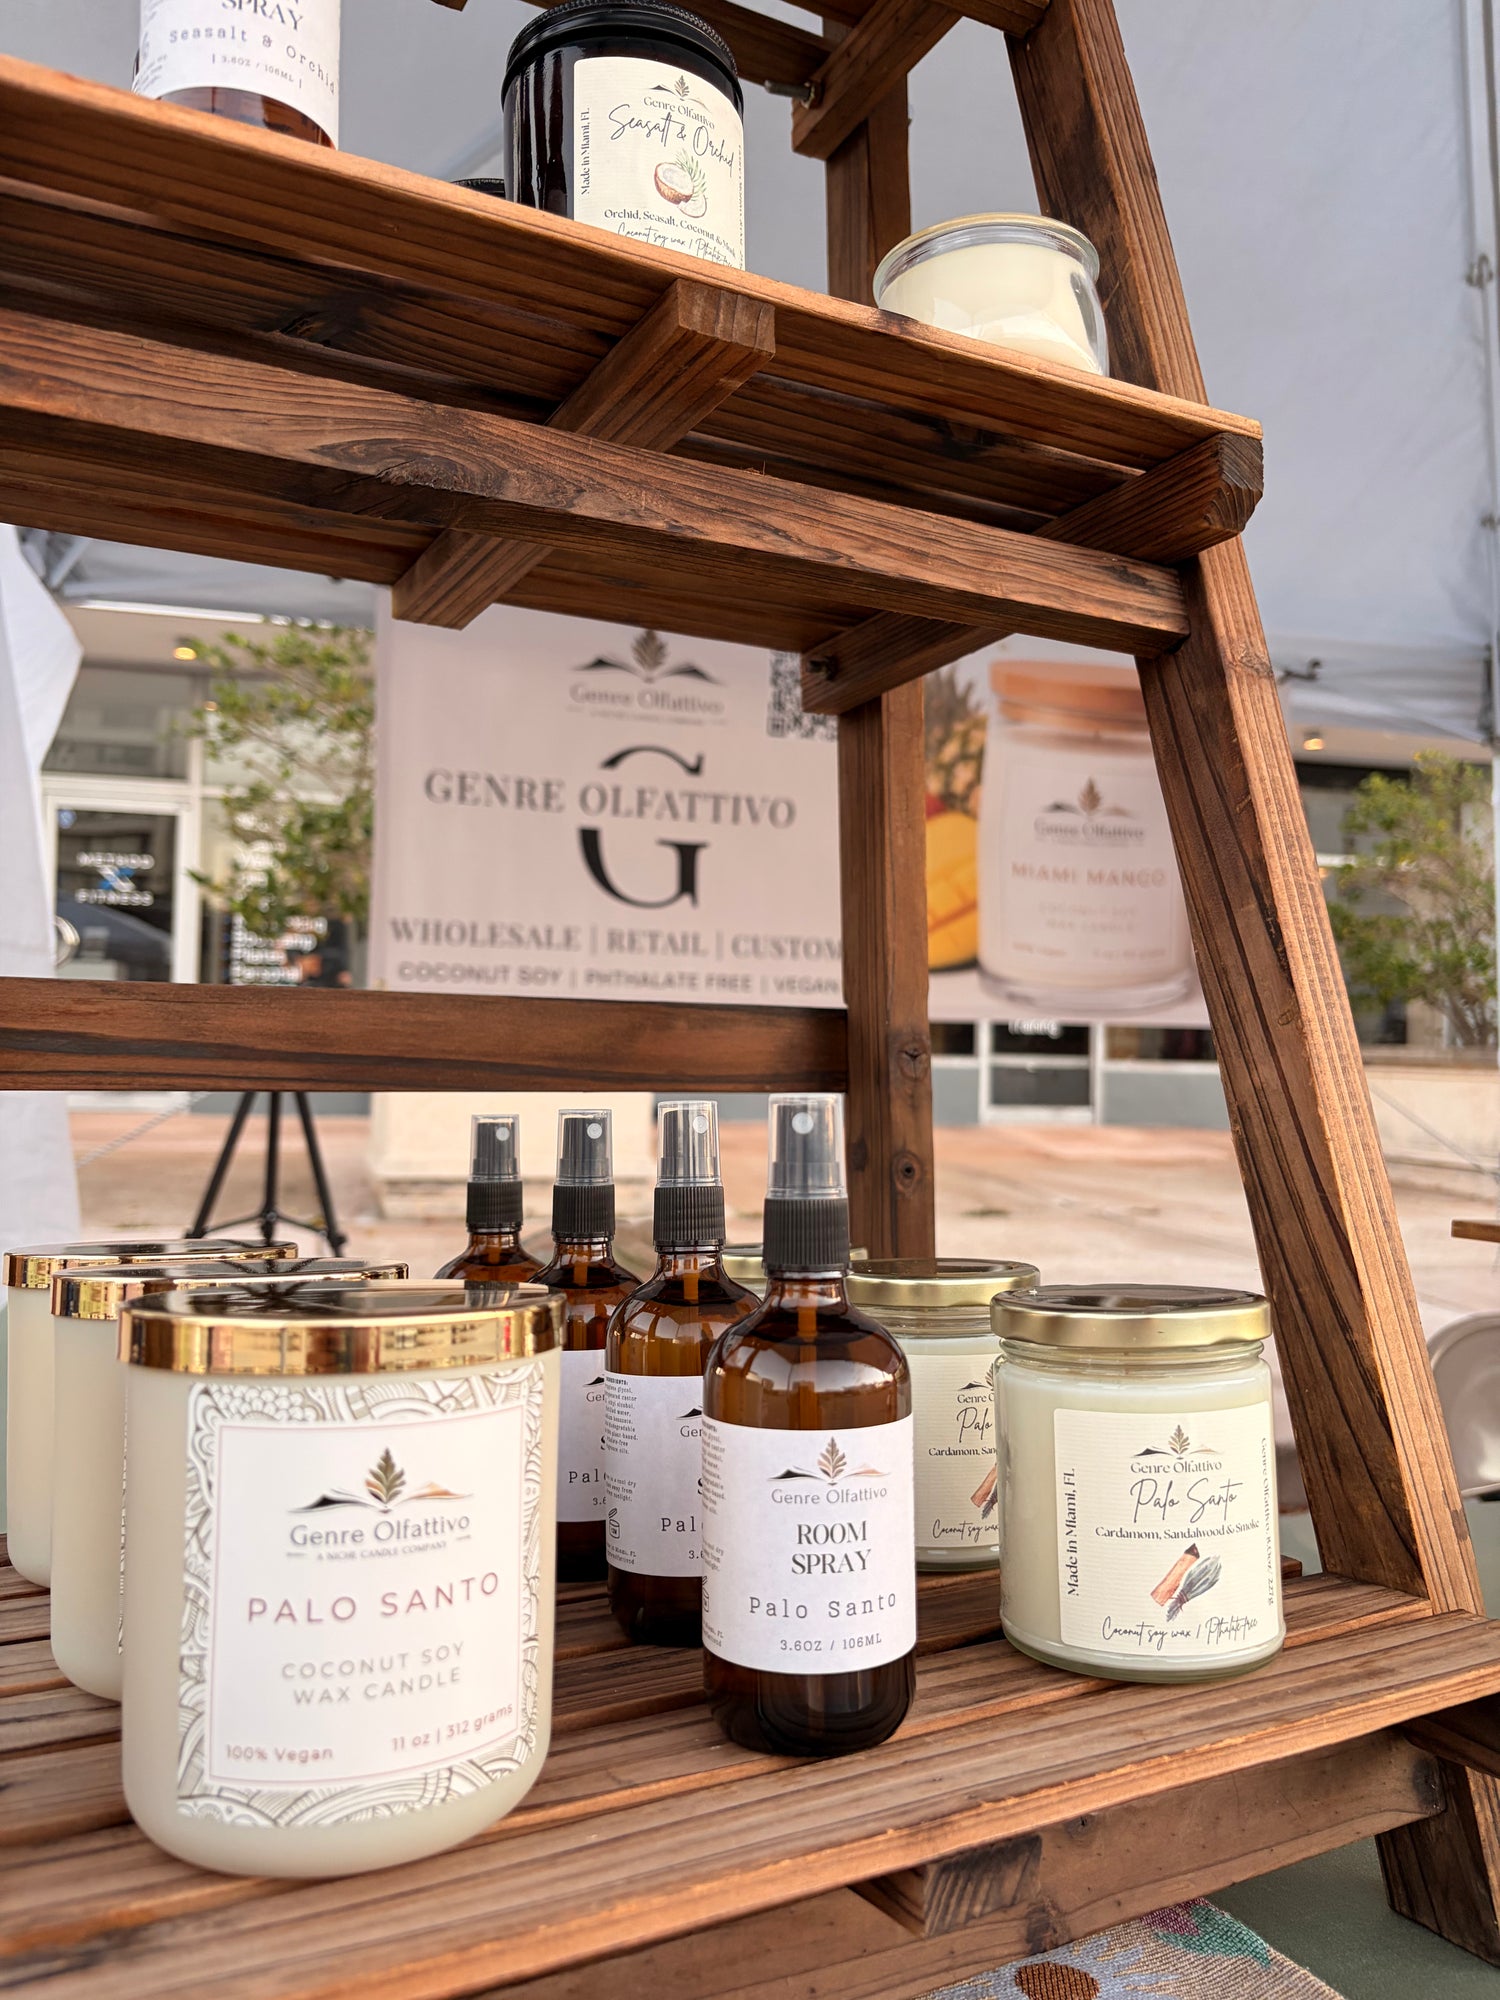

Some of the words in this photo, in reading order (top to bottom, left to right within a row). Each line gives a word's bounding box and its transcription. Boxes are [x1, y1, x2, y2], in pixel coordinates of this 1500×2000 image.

[169, 25, 247, 43] Seasalt
[262, 34, 272, 48] &
[286, 45, 336, 96] Orchid
[581, 108, 590, 121] FL
[643, 96, 675, 112] Genre
[677, 105, 715, 130] Olfattivo
[581, 122, 590, 153] Miami,
[608, 104, 683, 147] Seasalt
[676, 127, 686, 141] &
[693, 125, 734, 178] Orchid
[583, 154, 590, 166] in
[581, 166, 590, 195] Made
[604, 208, 641, 221] Orchid,
[643, 210, 678, 227] Seasalt,
[679, 220, 715, 240] Coconut
[569, 683, 631, 707] Genre
[637, 684, 725, 714] Olfattivo
[424, 768, 566, 815] GENRE
[579, 785, 797, 829] OLFATTIVO
[1011, 862, 1079, 884] MIAMI
[390, 917, 582, 952] WHOLESALE
[607, 928, 709, 958] RETAIL
[399, 961, 511, 986] COCONUT
[519, 965, 562, 987] SOY
[584, 967, 699, 992] PHTHALATE
[704, 973, 752, 993] FREE
[773, 974, 839, 995] VEGAN
[957, 1393, 987, 1404] Genre
[956, 1407, 993, 1443] Palo
[929, 1447, 980, 1457] Cardamom,
[1130, 1462, 1171, 1474] Genre
[1173, 1460, 1223, 1474] Olfattivo
[1063, 1468, 1075, 1486] FL
[771, 1488, 820, 1505] Genre
[826, 1487, 888, 1504] Olfattivo
[1130, 1478, 1180, 1523] Palo
[1186, 1477, 1243, 1524] Santo
[1065, 1489, 1077, 1537] Miami,
[290, 1524, 365, 1546] Genre
[374, 1515, 471, 1541] Olfattivo
[797, 1520, 868, 1545] ROOM
[933, 1519, 974, 1540] Coconut
[967, 1524, 984, 1543] soy
[1095, 1526, 1162, 1540] Cardamom,
[1163, 1524, 1225, 1540] Sandalwood
[1226, 1524, 1235, 1534] &
[1235, 1518, 1260, 1533] Smoke
[360, 1548, 399, 1558] CANDLE
[402, 1541, 447, 1554] COMPANY
[791, 1549, 872, 1575] SPRAY
[1067, 1540, 1077, 1553] in
[1065, 1556, 1079, 1597] Made
[247, 1597, 358, 1624] PALO
[380, 1571, 500, 1617] SANTO
[749, 1596, 809, 1619] Palo
[828, 1593, 896, 1618] Santo
[780, 1639, 822, 1652] 3.6OZ
[843, 1633, 882, 1650] 106ML
[1102, 1615, 1155, 1646] Coconut
[1148, 1629, 1168, 1651] soy
[1171, 1629, 1191, 1639] wax
[281, 1653, 409, 1680] COCONUT
[421, 1641, 466, 1665] SOY
[293, 1687, 350, 1705] WAX
[363, 1668, 462, 1701] CANDLE
[392, 1736, 404, 1751] 11
[406, 1732, 432, 1750] oz
[447, 1721, 471, 1738] 312
[474, 1703, 514, 1732] grams
[225, 1744, 266, 1761] 100%
[273, 1746, 334, 1764] Vegan
